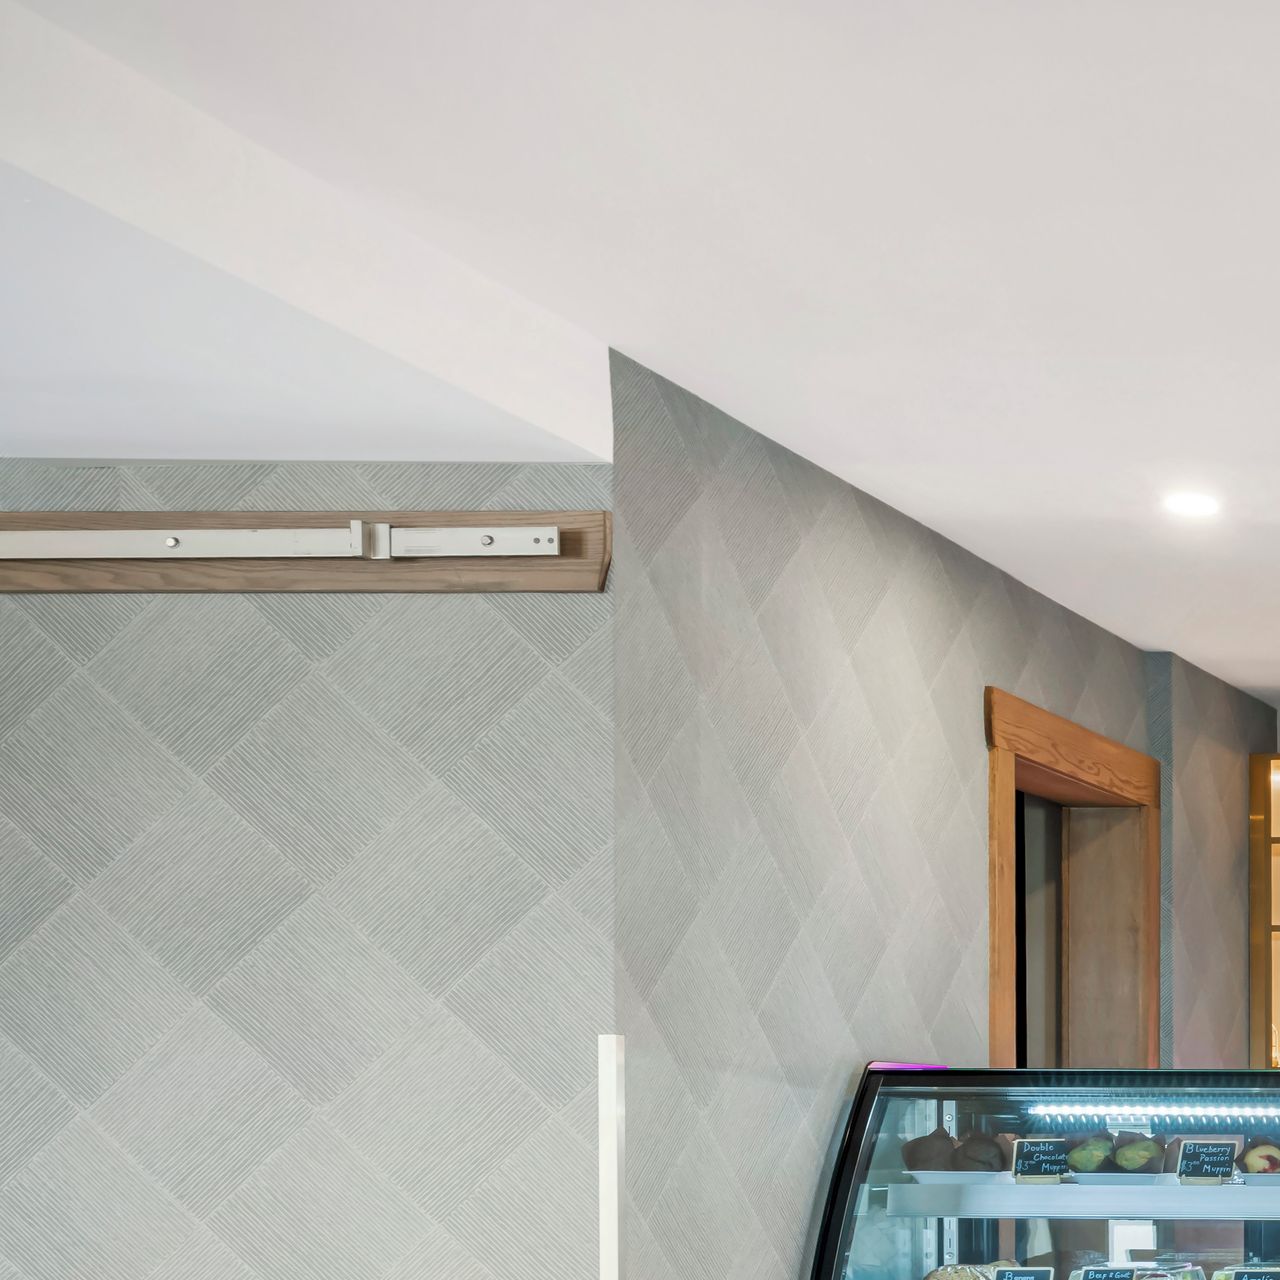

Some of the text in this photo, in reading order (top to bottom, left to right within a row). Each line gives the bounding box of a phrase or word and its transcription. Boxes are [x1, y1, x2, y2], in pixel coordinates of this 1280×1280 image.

[1185, 1143, 1231, 1155] Blueberry
[1033, 1153, 1067, 1161] Chocolat
[1200, 1153, 1230, 1163] Passion
